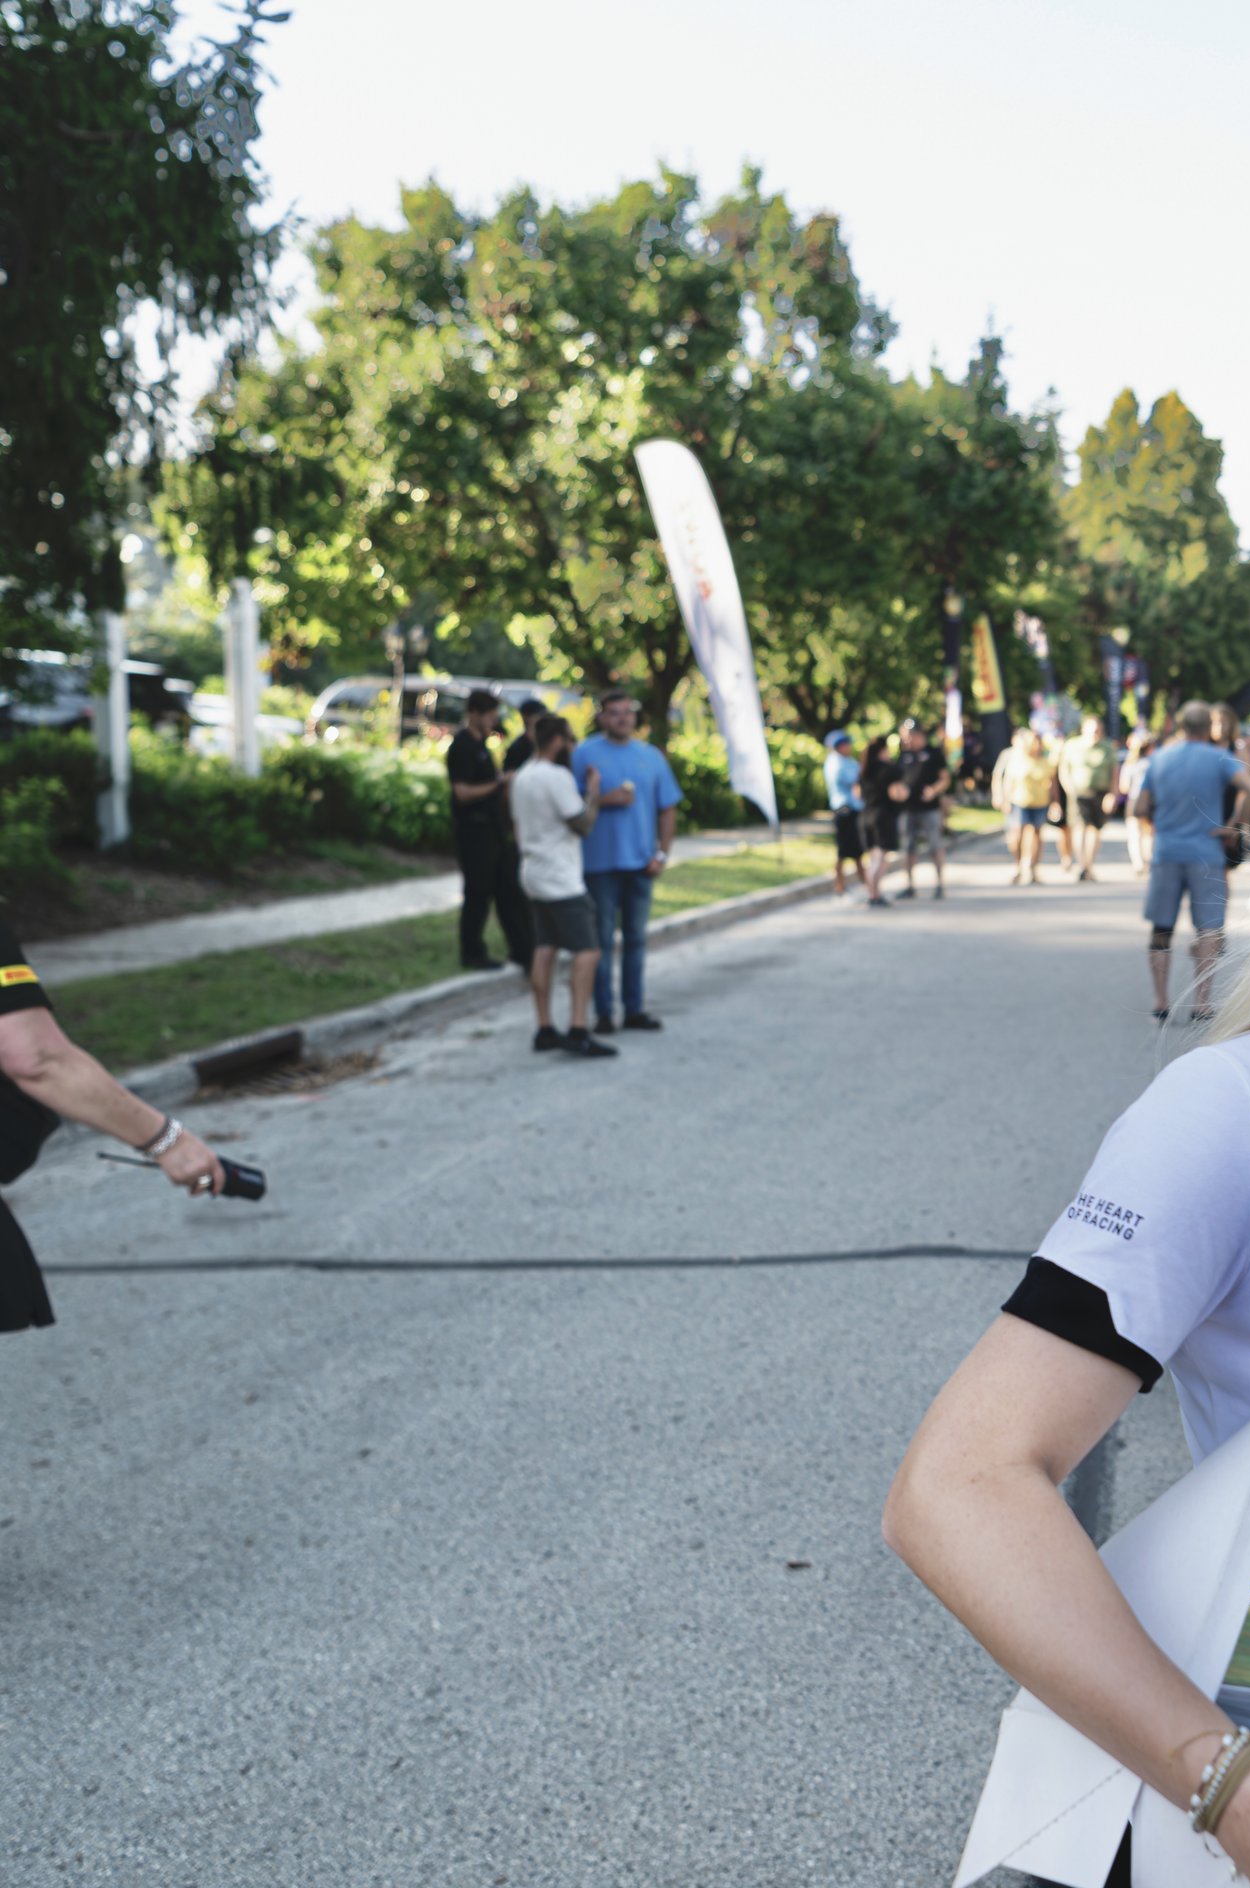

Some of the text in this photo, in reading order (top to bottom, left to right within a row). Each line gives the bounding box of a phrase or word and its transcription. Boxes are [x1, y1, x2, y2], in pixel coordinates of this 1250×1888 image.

[1067, 1206, 1135, 1241] OF RACING
[1094, 1199, 1145, 1228] HEART
